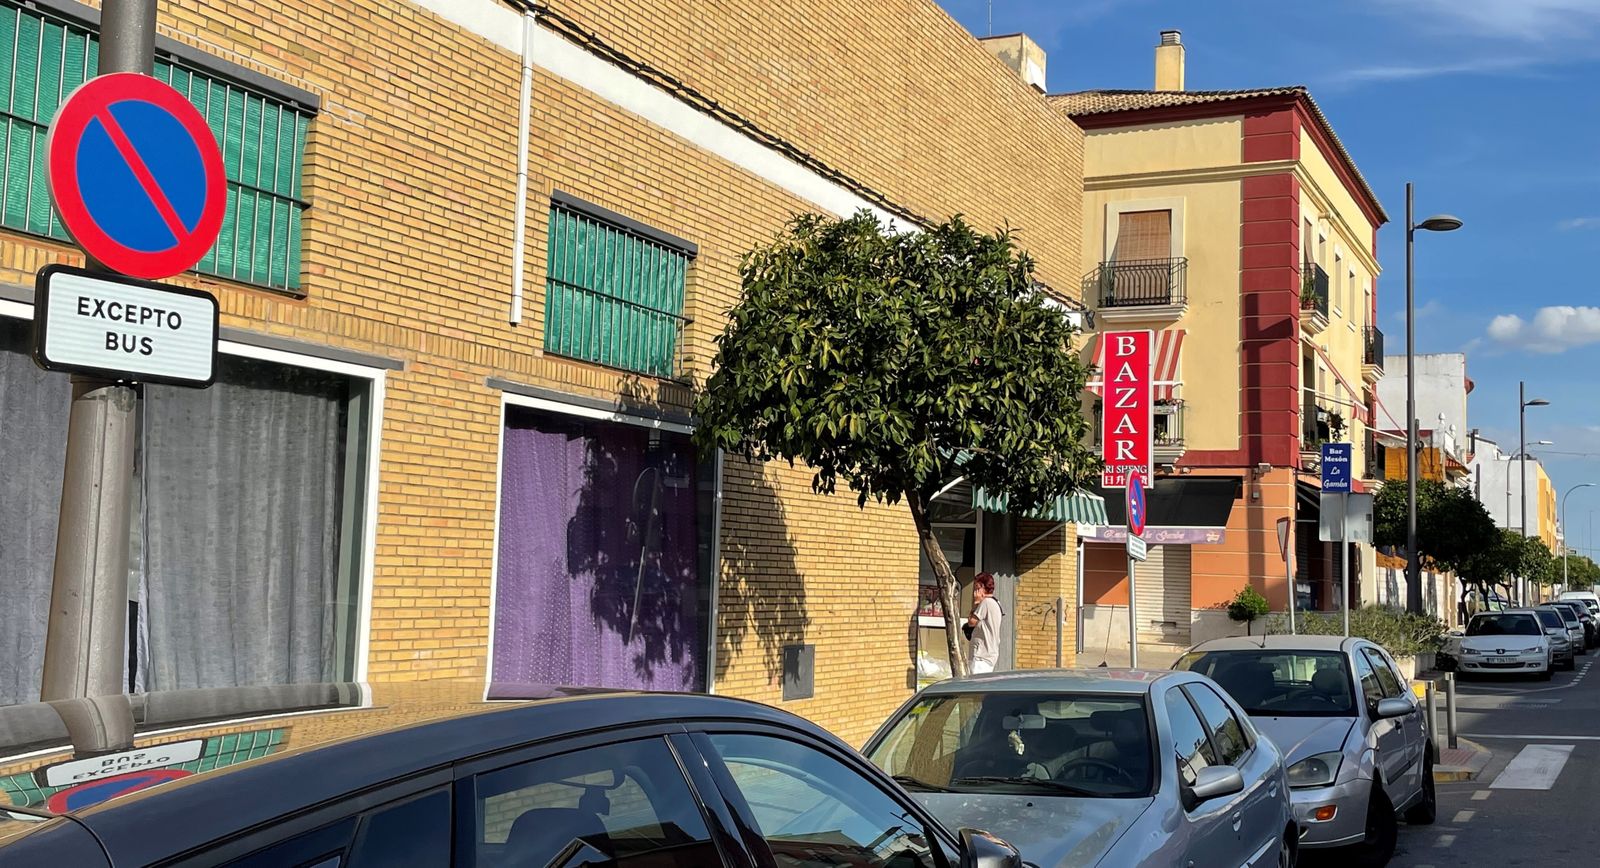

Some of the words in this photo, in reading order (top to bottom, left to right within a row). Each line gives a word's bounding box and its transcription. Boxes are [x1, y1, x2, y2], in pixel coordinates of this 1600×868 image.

[77, 296, 182, 330] EXCEPTO
[105, 331, 153, 355] BUS
[1113, 336, 1138, 460] BAZAR
[1105, 465, 1114, 473] RI
[1330, 466, 1341, 475] La
[1323, 478, 1348, 489] Gamba
